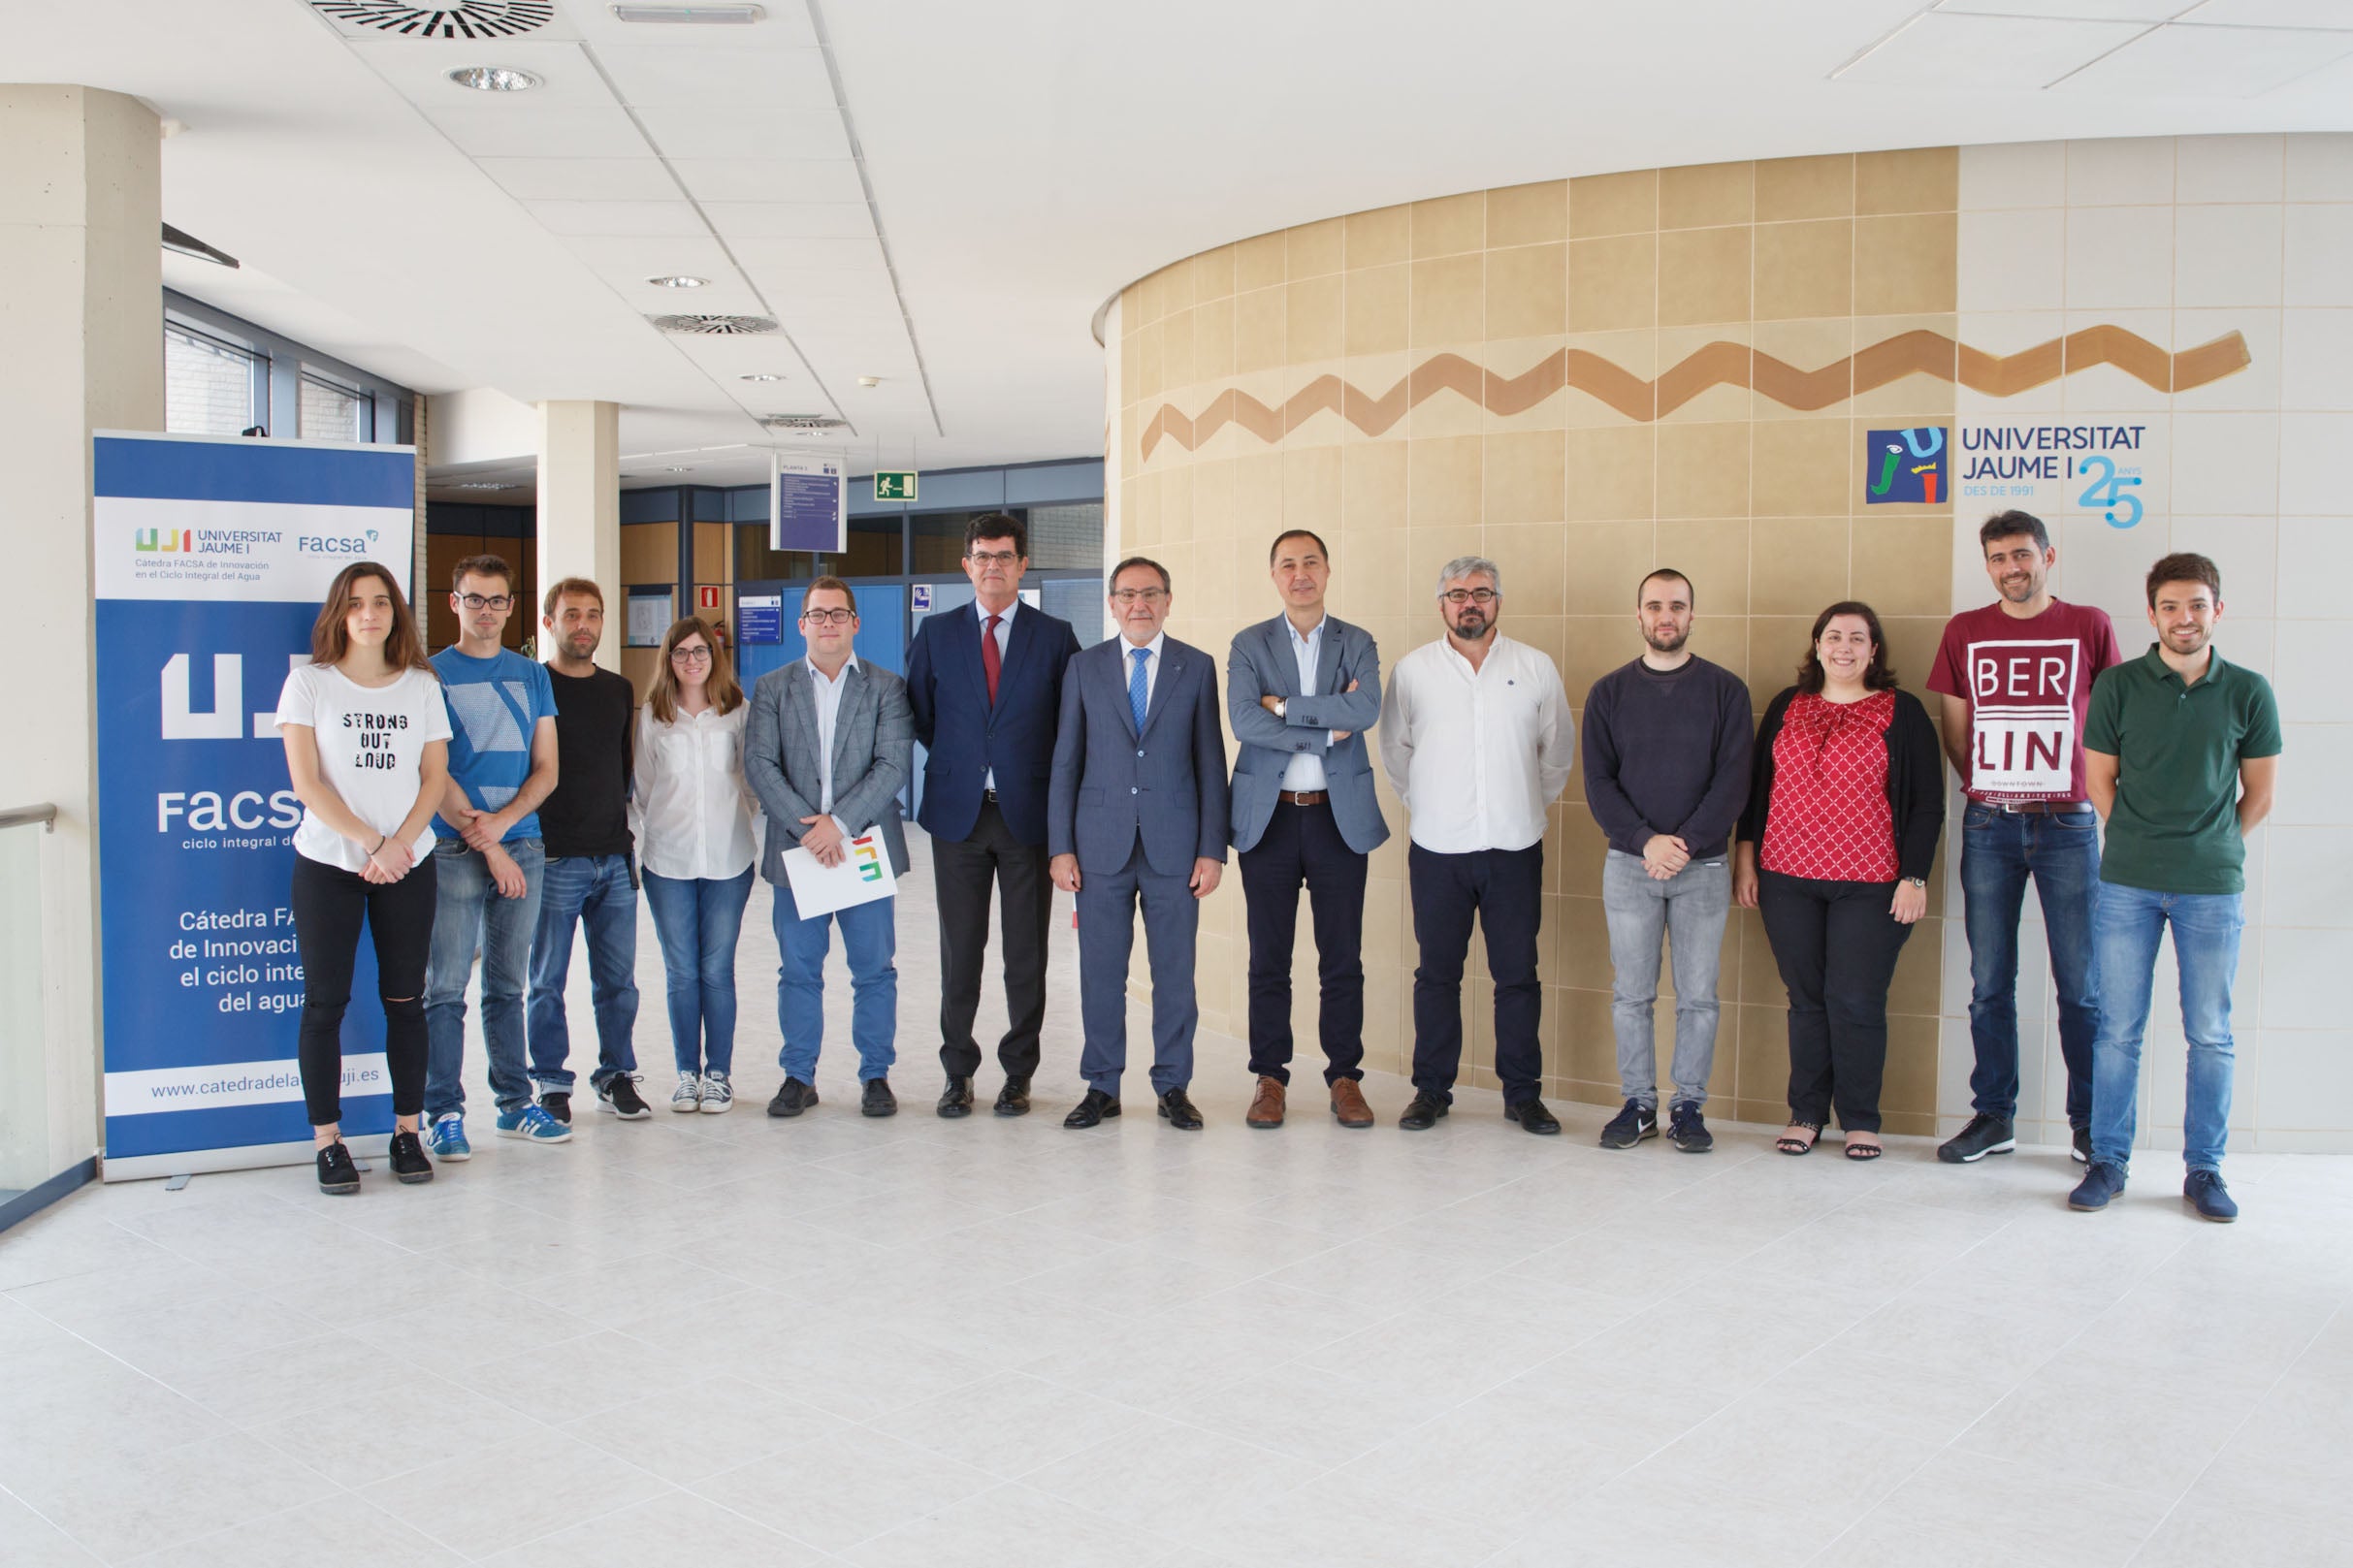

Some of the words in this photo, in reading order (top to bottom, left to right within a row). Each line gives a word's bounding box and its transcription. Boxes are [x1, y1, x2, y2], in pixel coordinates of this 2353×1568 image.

[1962, 427, 2145, 451] UNIVERSITAT
[1963, 456, 2058, 480] JAUME
[2067, 456, 2073, 479] I
[2117, 466, 2143, 475] ANYS
[1963, 485, 1986, 496] DES
[1990, 485, 2007, 496] DE
[2010, 485, 2034, 496] 1991
[2078, 455, 2143, 529] 25
[198, 529, 283, 543] UNIVERSITAT
[198, 542, 243, 555] JAUME
[175, 560, 204, 568] FACSA
[207, 560, 218, 569] de
[220, 561, 270, 570] Innovación
[149, 570, 157, 579] el
[160, 570, 182, 580] Ciclo
[185, 571, 219, 582] Integral
[222, 572, 235, 581] del
[238, 572, 261, 583] Agua
[1977, 656, 2066, 697] BER
[342, 713, 407, 729] STRONG
[361, 732, 391, 750] OUT
[1978, 731, 2063, 771] LIN
[355, 752, 396, 770] LOUD
[158, 789, 302, 833] Facs
[182, 838, 217, 849] ciclo
[223, 836, 276, 850] integral
[179, 908, 267, 931] Cátedra
[169, 939, 197, 959] de
[204, 933, 298, 958] Innovaci
[180, 967, 200, 987] el
[207, 964, 259, 986] ciclo
[266, 963, 305, 982] inte
[218, 991, 251, 1013] del
